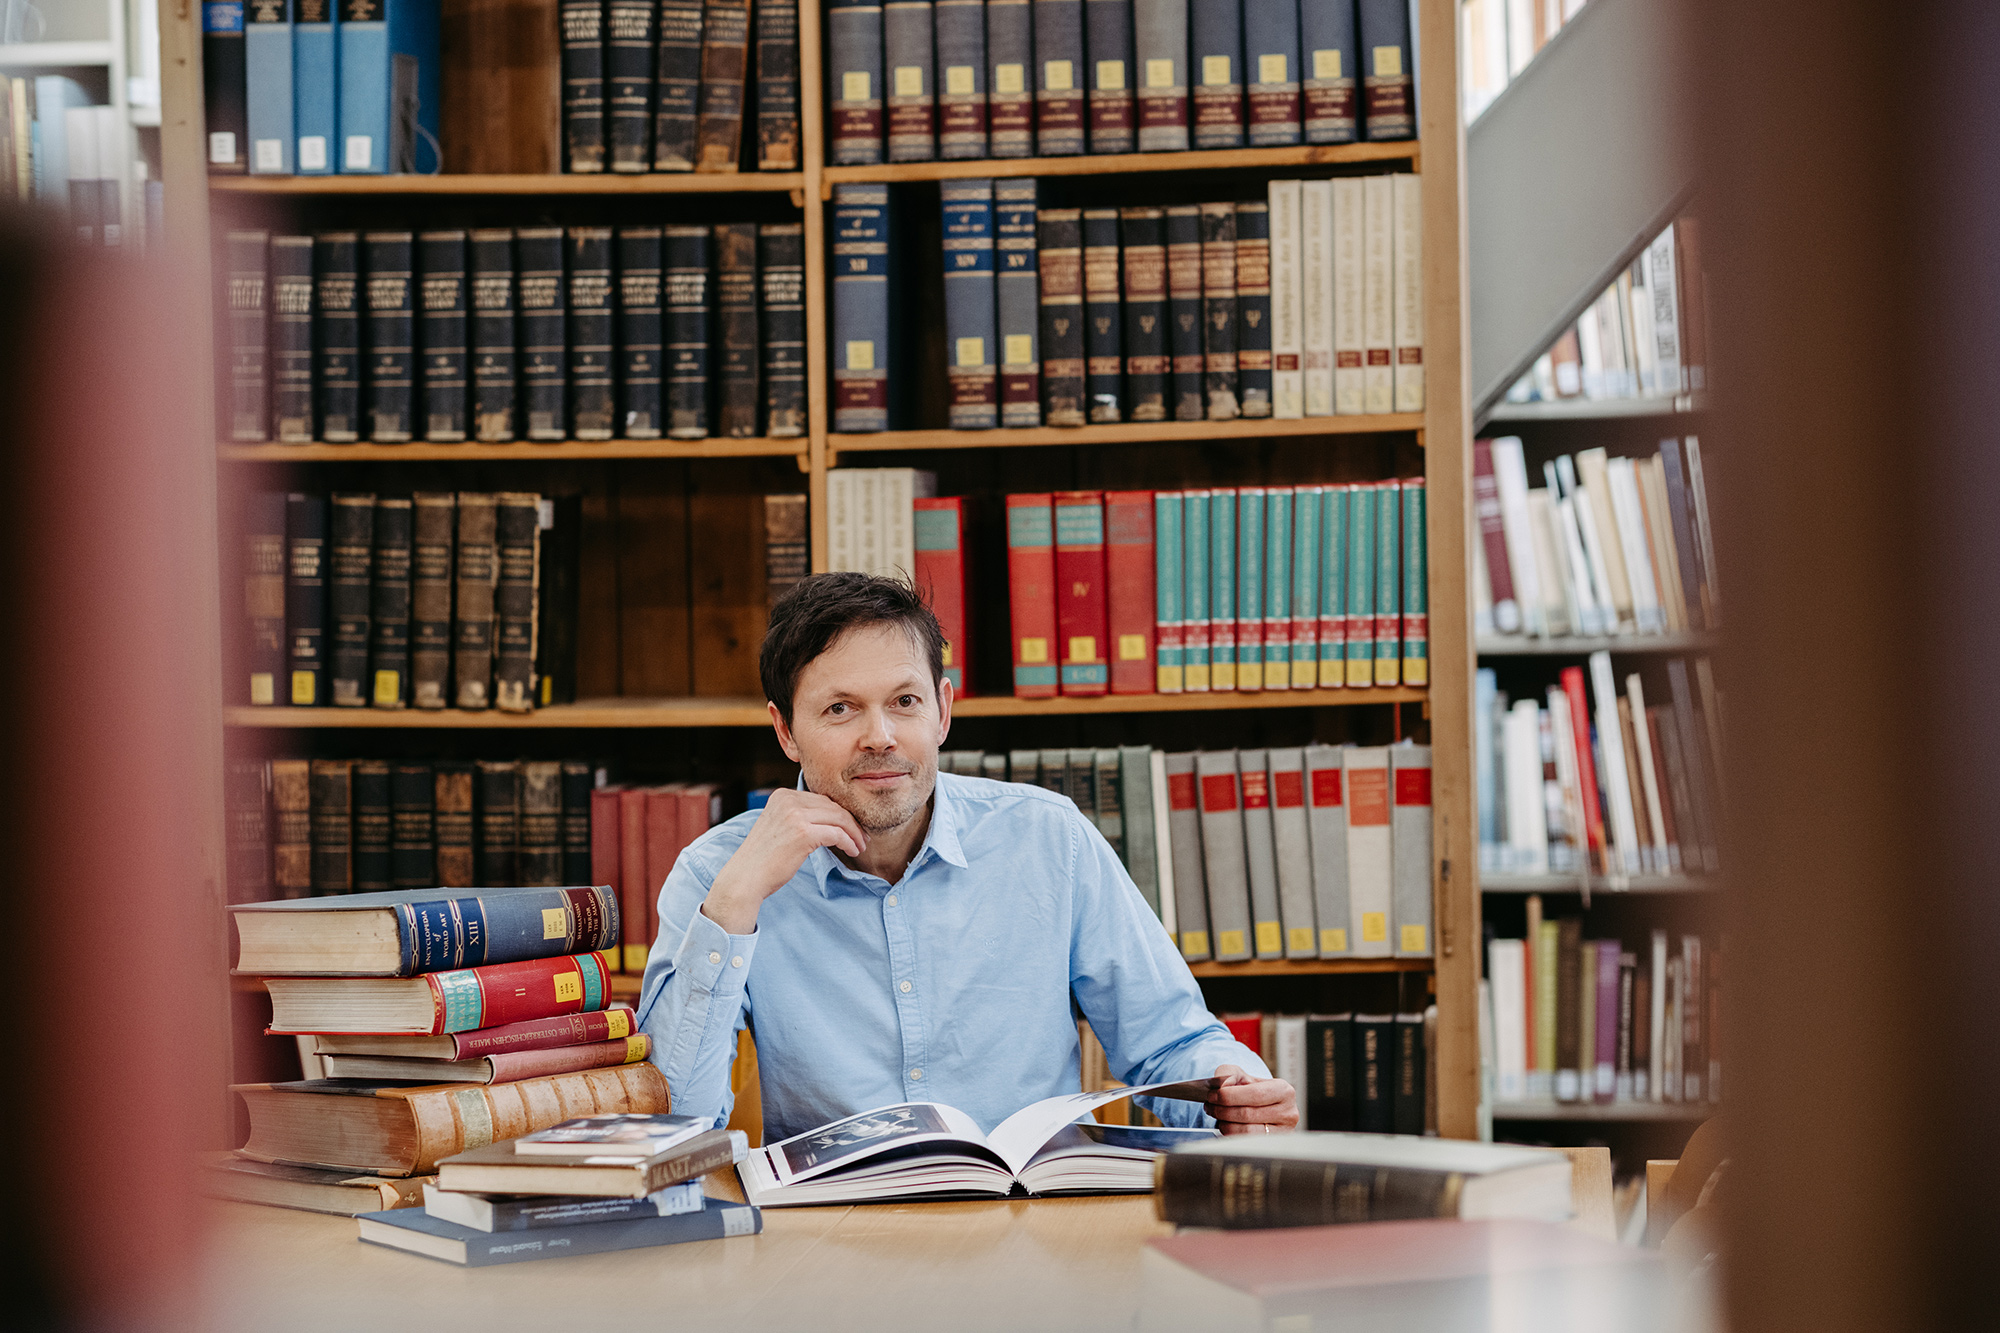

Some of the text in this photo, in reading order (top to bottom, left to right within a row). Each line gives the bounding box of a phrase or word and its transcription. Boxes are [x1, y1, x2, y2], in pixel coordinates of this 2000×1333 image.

[1007, 254, 1027, 267] XV
[586, 892, 598, 916] MALIGN
[439, 912, 447, 928] ART
[574, 902, 582, 940] SHAMANISM
[421, 910, 431, 966] ENCYCLOPEDIA
[432, 932, 441, 942] of
[468, 920, 479, 946] XIII
[590, 933, 598, 947] AND
[515, 988, 526, 996] II
[560, 1026, 570, 1036] DIE
[469, 1038, 491, 1048] MALER
